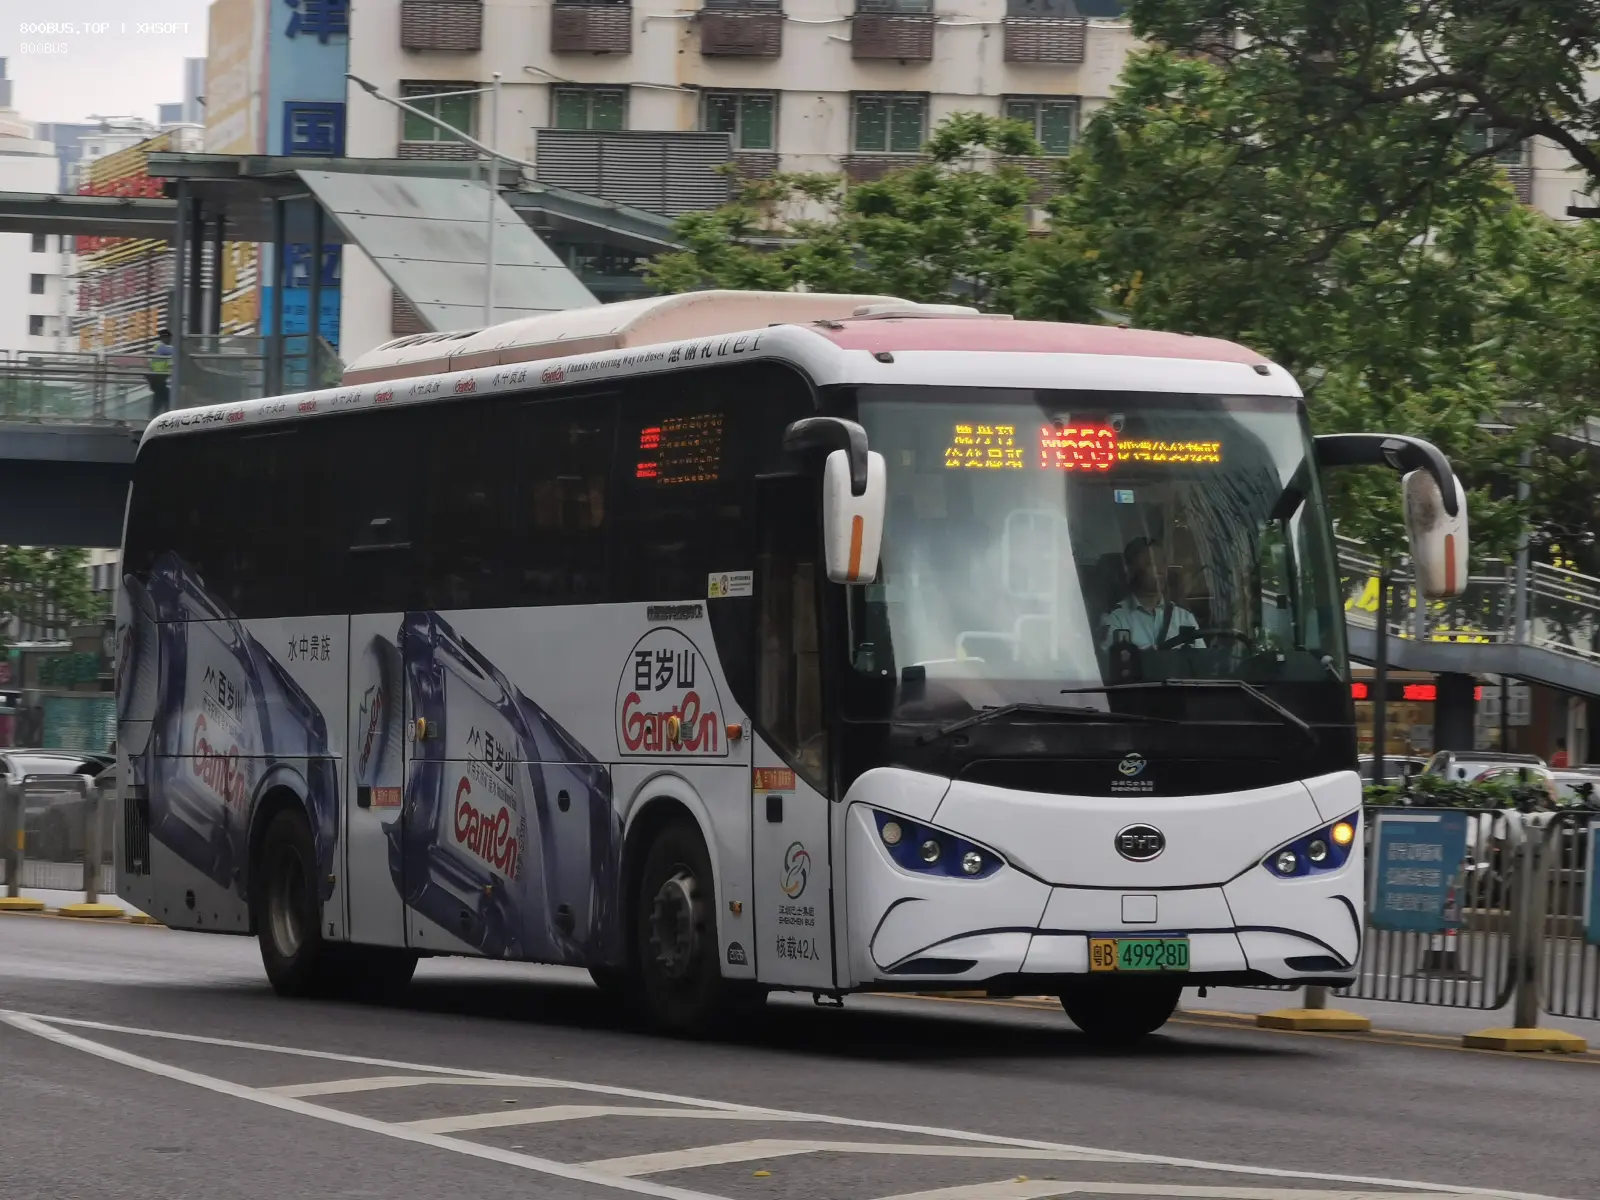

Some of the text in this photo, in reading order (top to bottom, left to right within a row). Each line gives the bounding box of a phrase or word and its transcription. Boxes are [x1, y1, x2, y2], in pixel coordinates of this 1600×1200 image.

[287, 634, 331, 662] 水中贵族
[635, 649, 695, 691] 百岁山
[218, 669, 244, 722] 百岁山
[485, 731, 514, 786] 百岁山
[454, 776, 518, 880] Ganten
[1121, 835, 1159, 849] BYD
[776, 935, 820, 961] 核载42人
